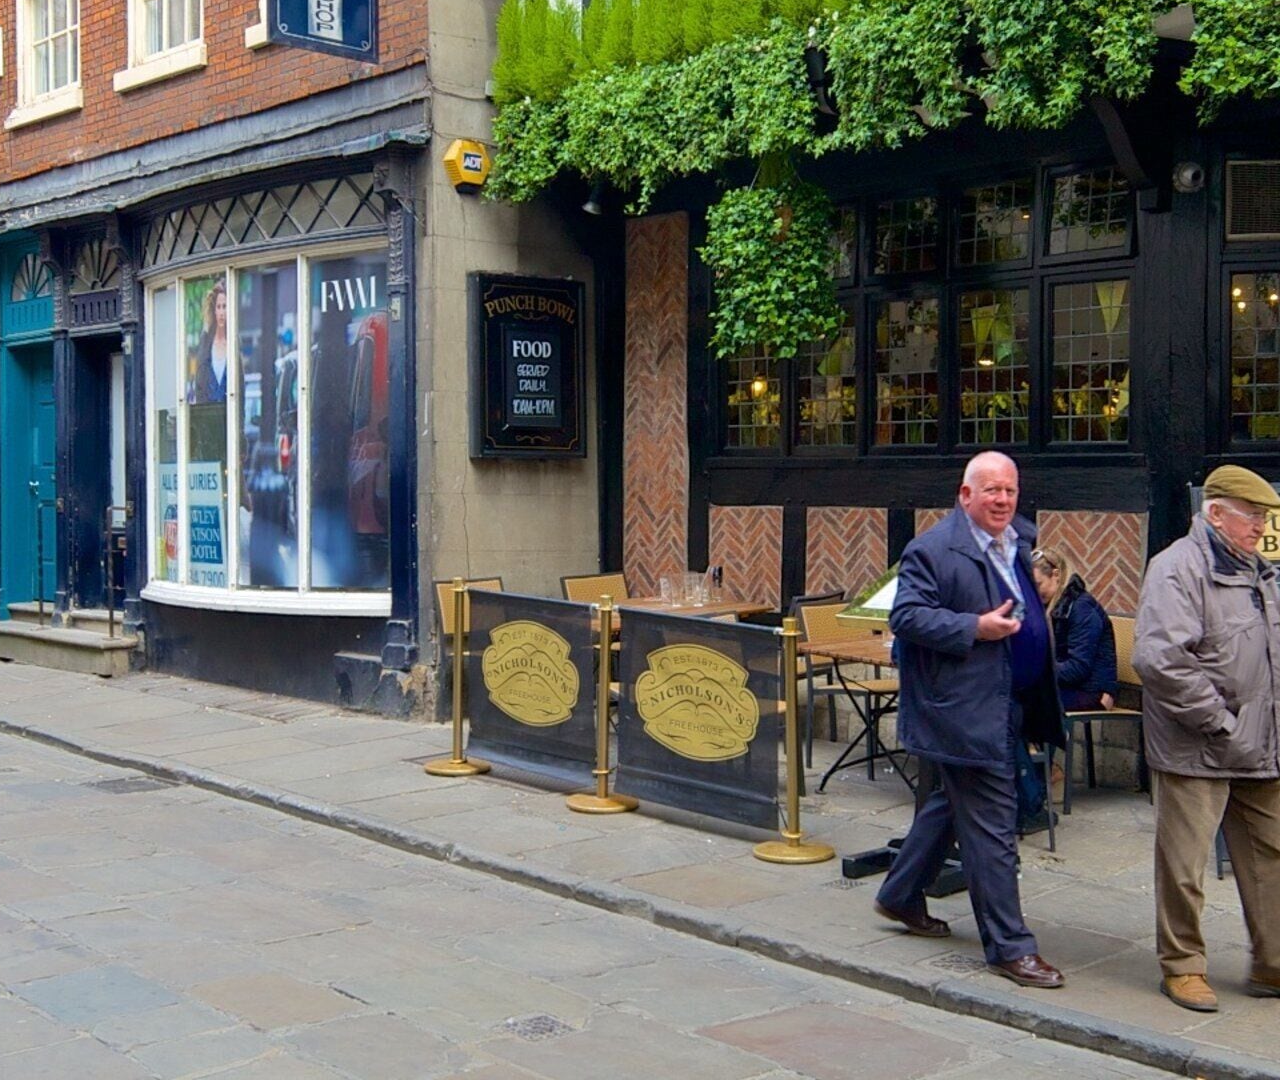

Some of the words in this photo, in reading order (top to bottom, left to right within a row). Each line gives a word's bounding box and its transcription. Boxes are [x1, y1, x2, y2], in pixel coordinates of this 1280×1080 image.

[464, 157, 481, 169] ADT
[483, 294, 534, 318] PUNCH
[537, 297, 576, 324] BOWL
[512, 339, 552, 359] FOOD
[516, 364, 550, 377] SERVED
[492, 657, 569, 694] NICHOLSON'S
[508, 688, 551, 704] FREEHOUSE
[649, 684, 746, 726] NICHOLSON'S
[668, 718, 725, 737] FREEHOUSE
